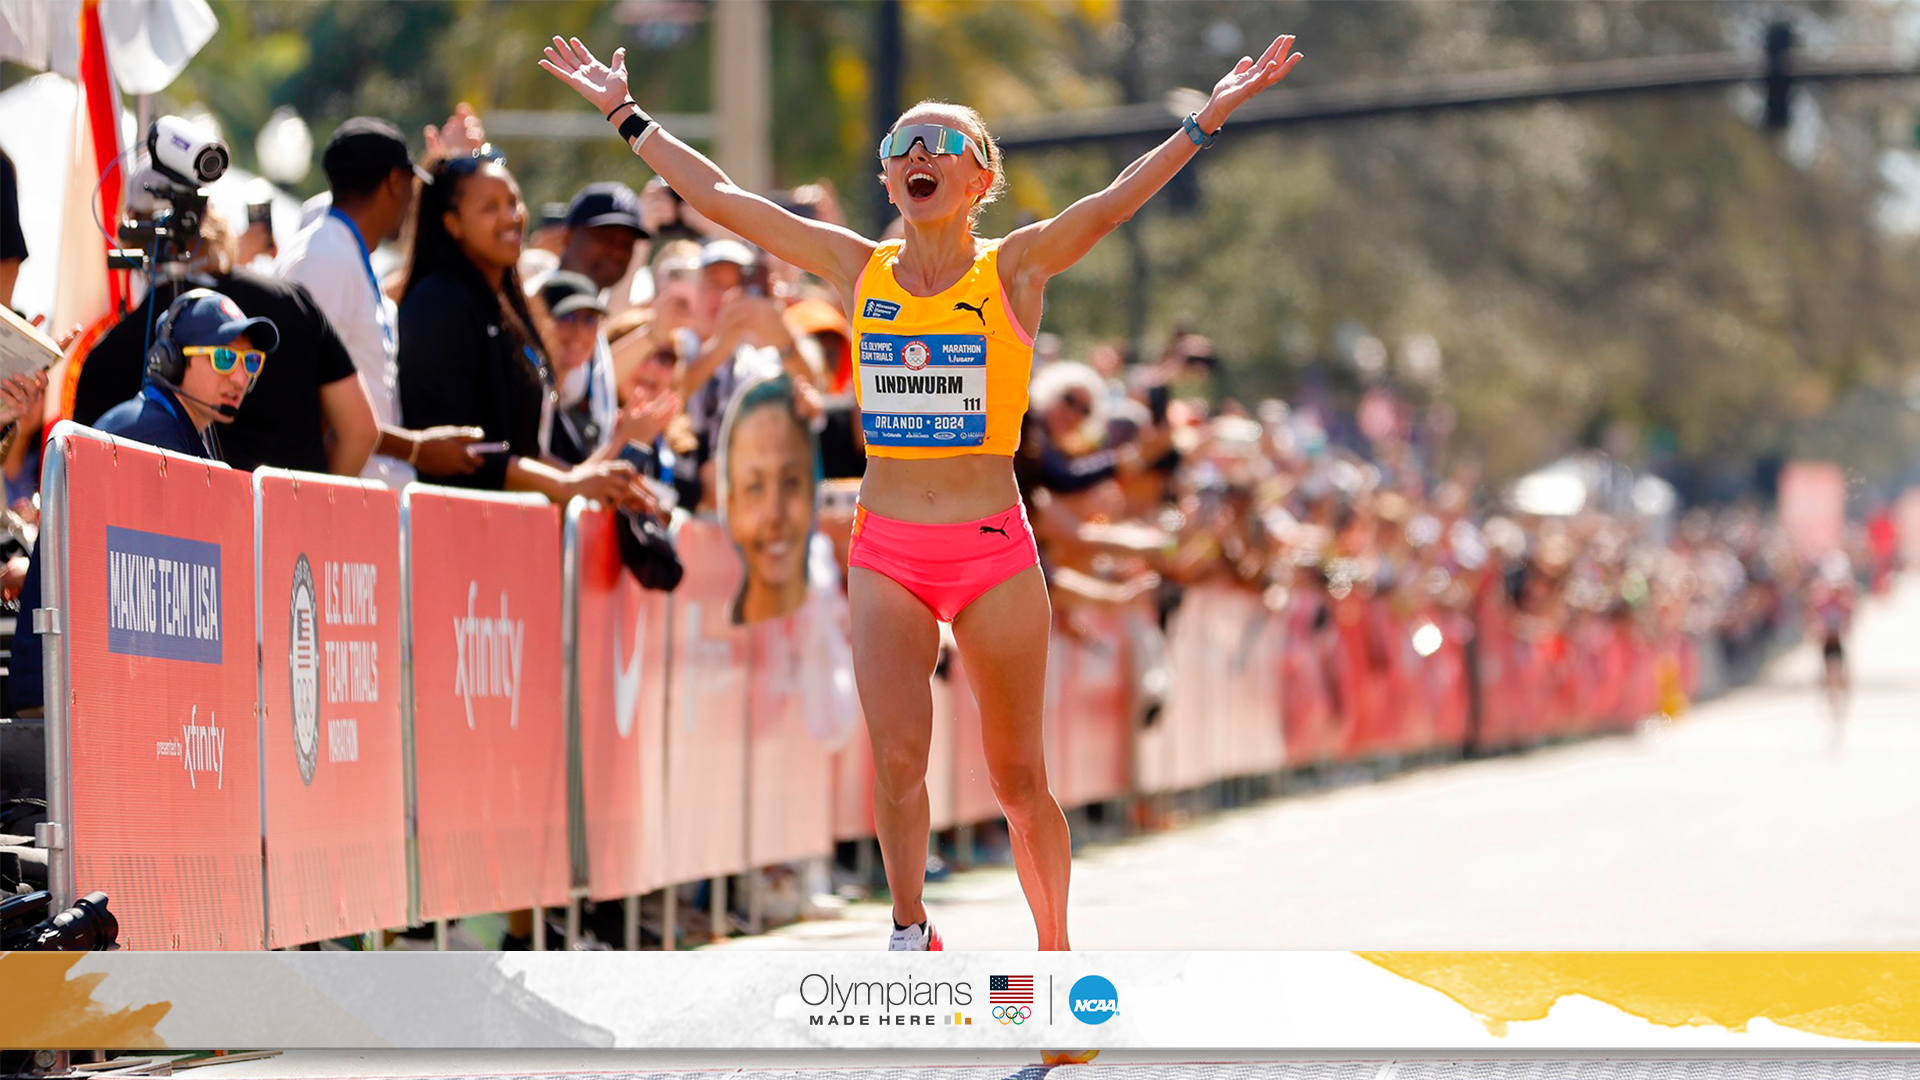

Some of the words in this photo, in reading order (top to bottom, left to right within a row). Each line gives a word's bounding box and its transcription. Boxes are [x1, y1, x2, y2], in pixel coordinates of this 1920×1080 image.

[868, 342, 893, 351] OLYMPIC
[873, 352, 894, 361] TRIALS
[942, 344, 982, 353] MARATHON
[875, 374, 963, 394] LINDWURM
[963, 397, 981, 411] 111
[875, 416, 923, 429] ORLANDO
[934, 416, 965, 430] 2024
[110, 551, 156, 633] MAKING
[158, 558, 191, 638] TEAM
[193, 564, 219, 641] USA
[324, 561, 341, 625] U.S.
[342, 561, 378, 626] OLYMPIC
[454, 578, 524, 731] xfinity
[325, 640, 348, 703] TEAM
[349, 640, 379, 702] TRIALS
[183, 704, 225, 790] xfinity
[327, 718, 359, 763] MARATHON
